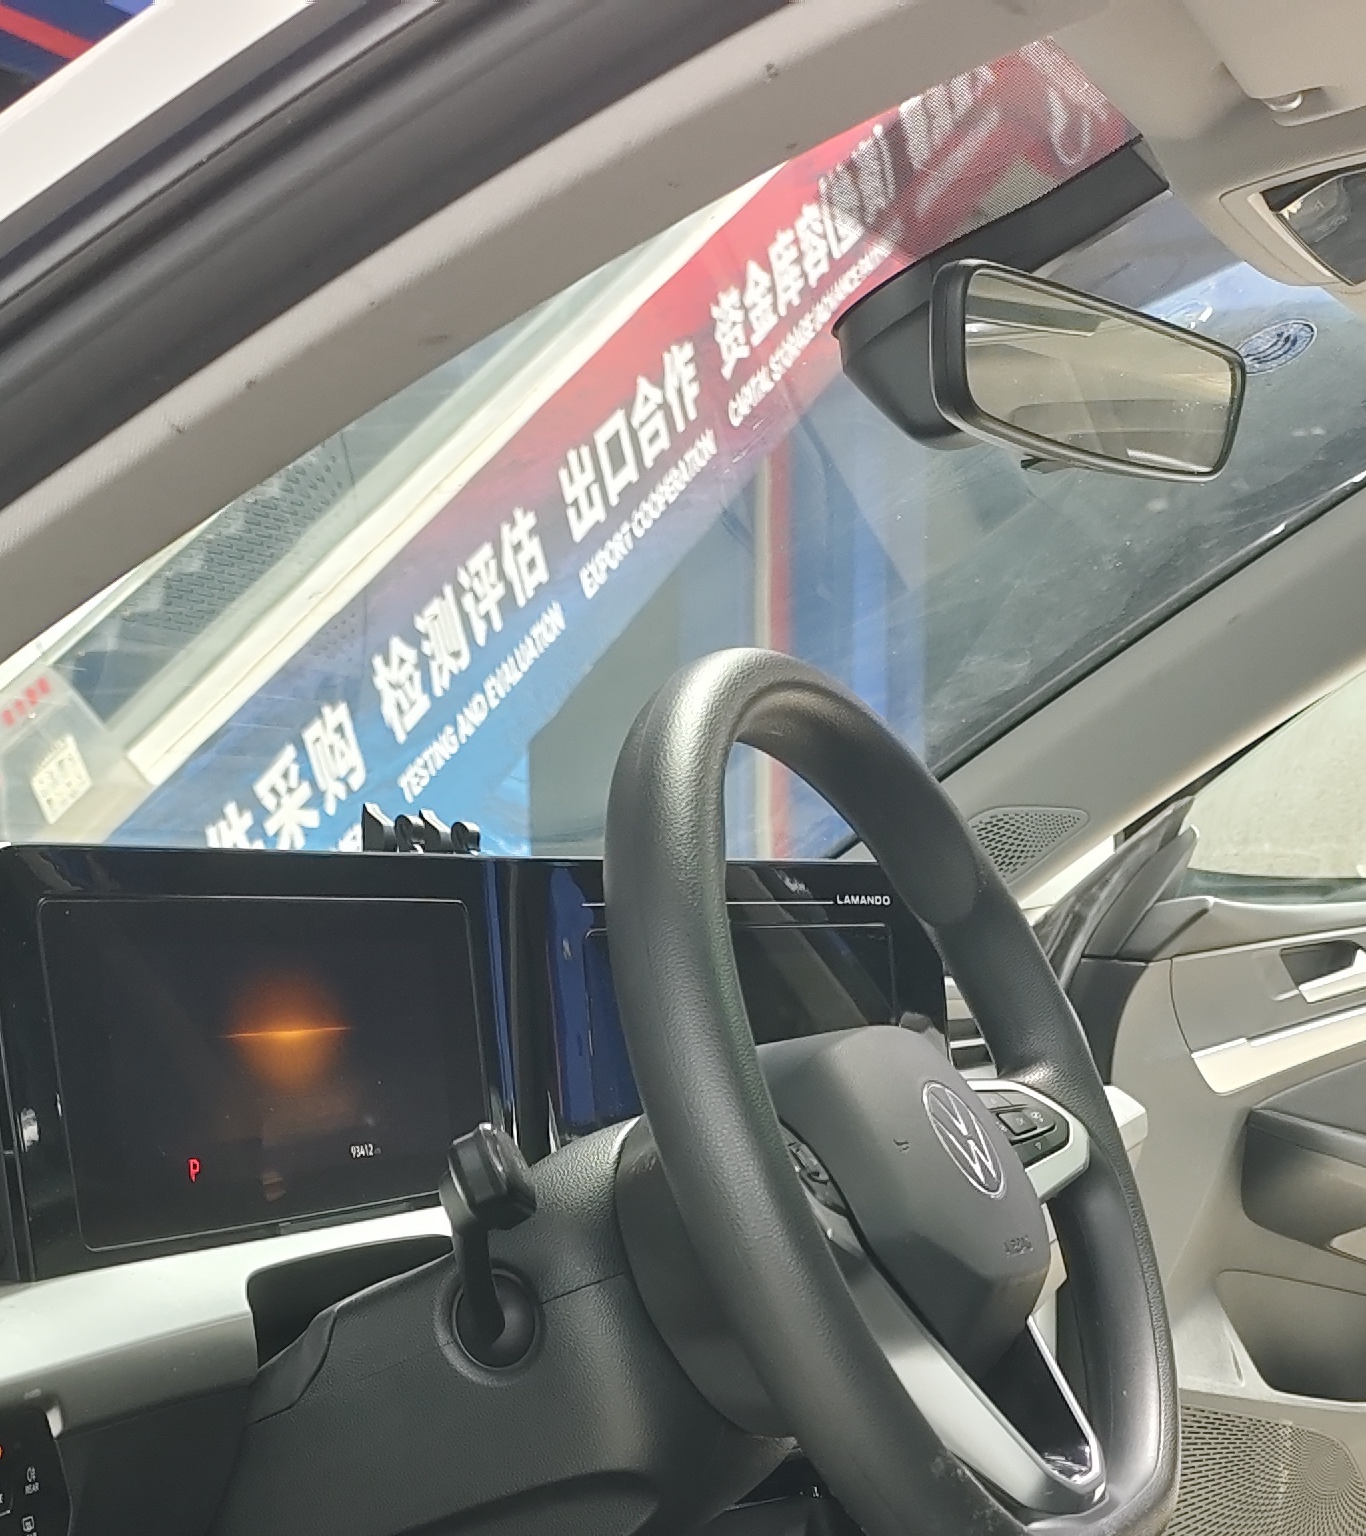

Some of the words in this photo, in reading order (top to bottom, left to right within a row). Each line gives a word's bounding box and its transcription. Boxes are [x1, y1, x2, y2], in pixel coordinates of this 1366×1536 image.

[372, 507, 549, 744] 检测评估
[558, 341, 699, 542] 出口合作
[398, 725, 459, 802] TESTING
[457, 693, 488, 744] AND
[483, 601, 565, 708] EVALUATION
[579, 520, 634, 599] EXPORT
[632, 428, 717, 538] COOPERATION
[836, 894, 891, 906] LAMANDO
[350, 1143, 374, 1159] 93412
[188, 1158, 200, 1182] P
